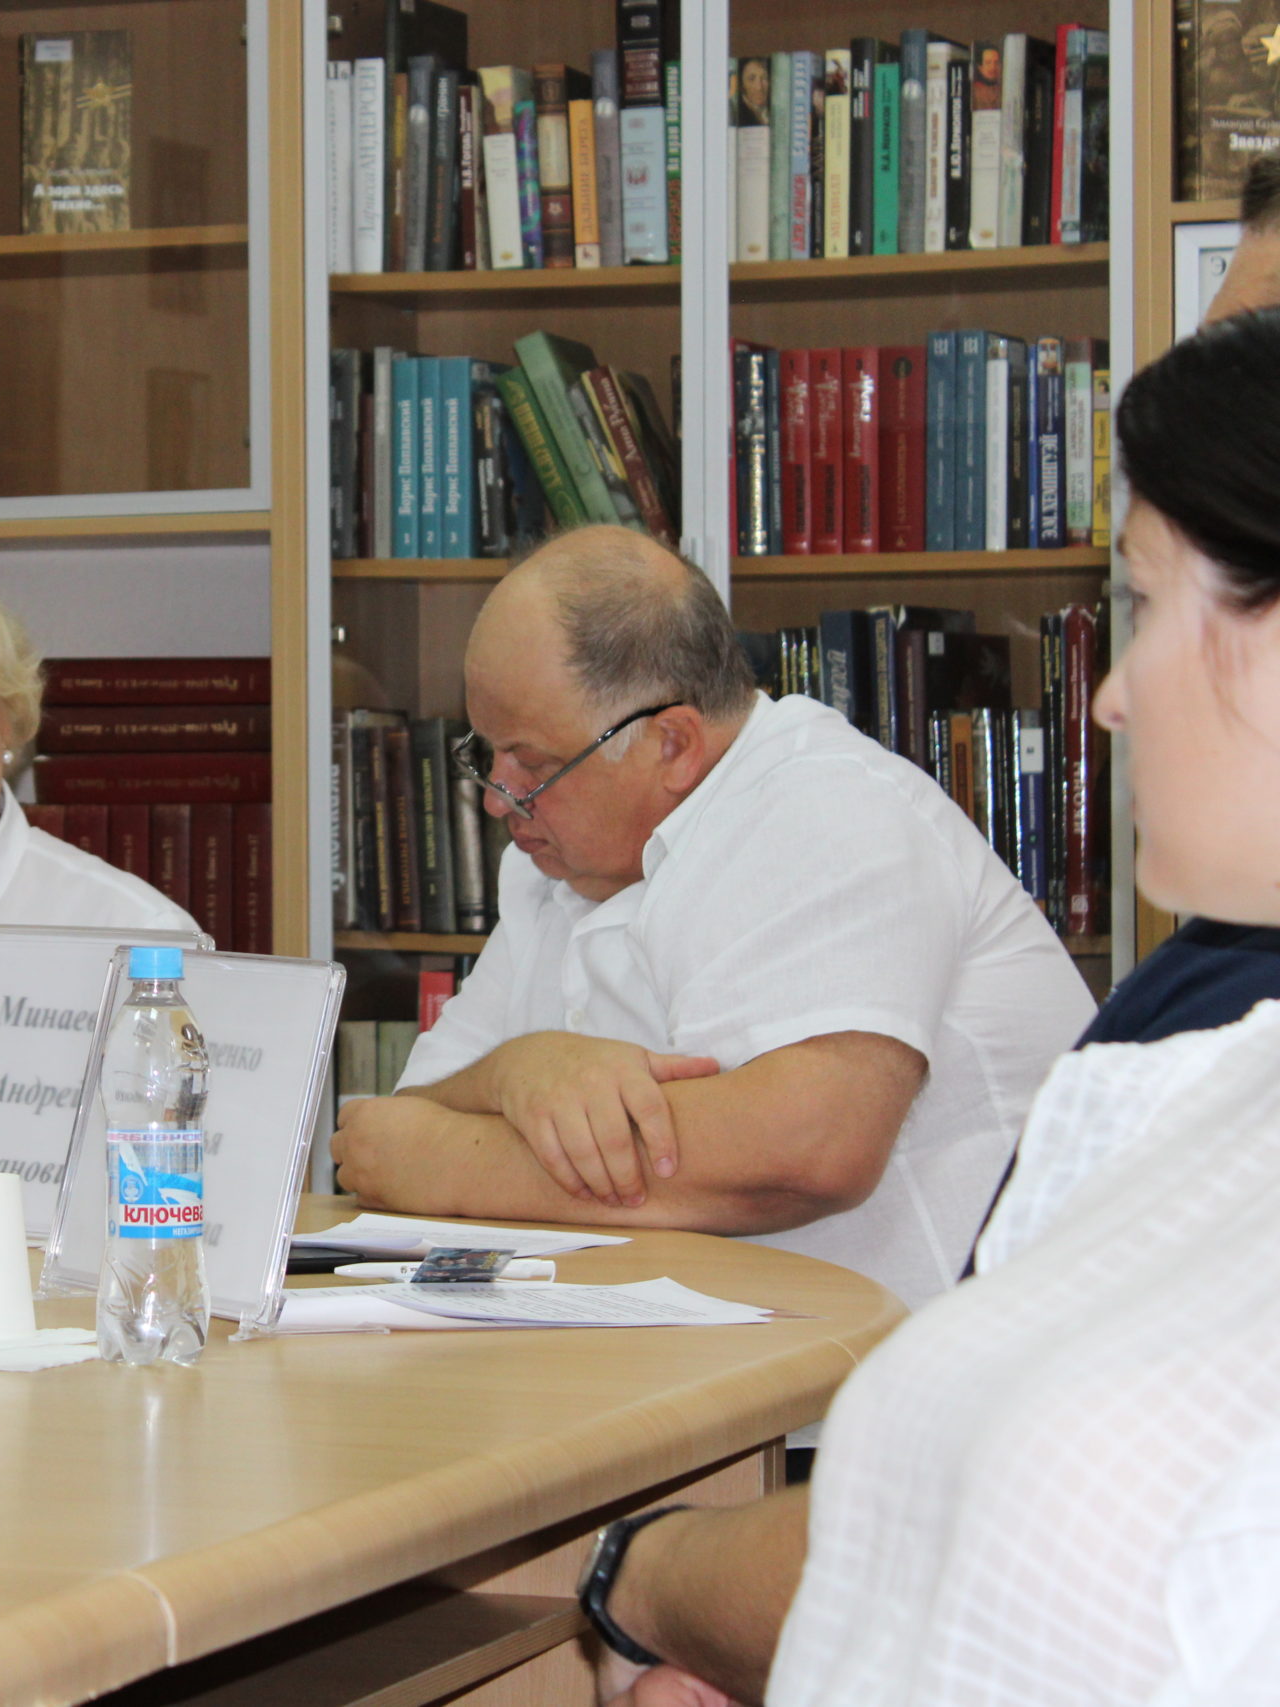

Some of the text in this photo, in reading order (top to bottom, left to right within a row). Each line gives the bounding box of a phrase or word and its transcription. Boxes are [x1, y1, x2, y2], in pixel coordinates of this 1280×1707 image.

[398, 399, 411, 476] Поплавский
[422, 397, 433, 475] Поплавский
[445, 397, 458, 475] Поплавский
[398, 479, 415, 516] Борис
[422, 478, 438, 515] Борис
[446, 478, 462, 515] Борис
[123, 1203, 203, 1226] ключев
